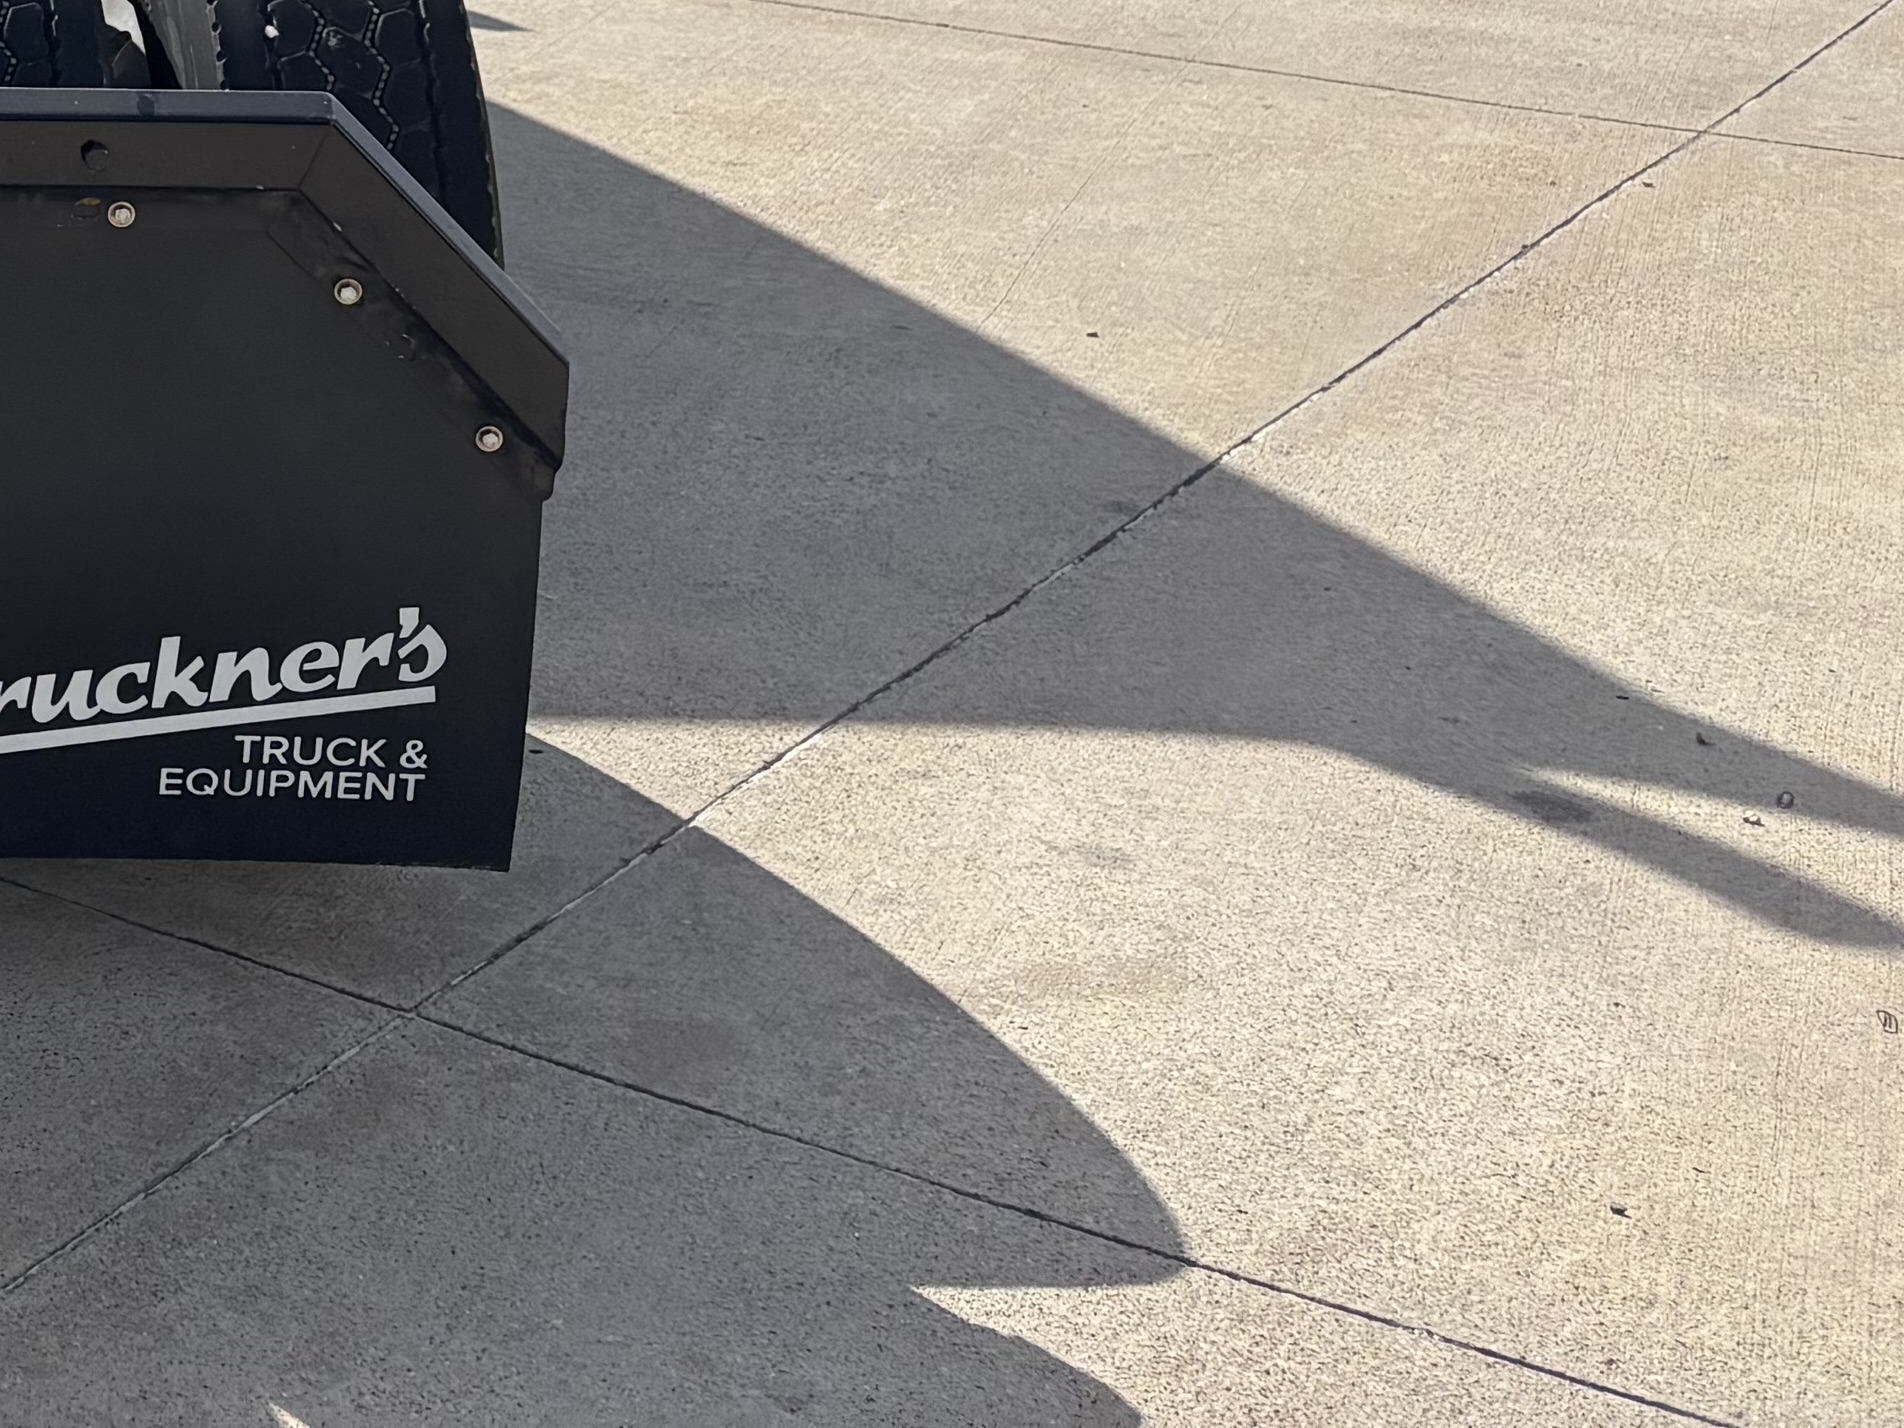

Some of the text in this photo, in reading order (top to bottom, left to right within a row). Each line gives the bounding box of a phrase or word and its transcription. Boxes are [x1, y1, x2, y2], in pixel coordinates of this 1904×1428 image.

[234, 735, 429, 770] TRUCK &
[158, 767, 427, 802] EQUIPMENT
